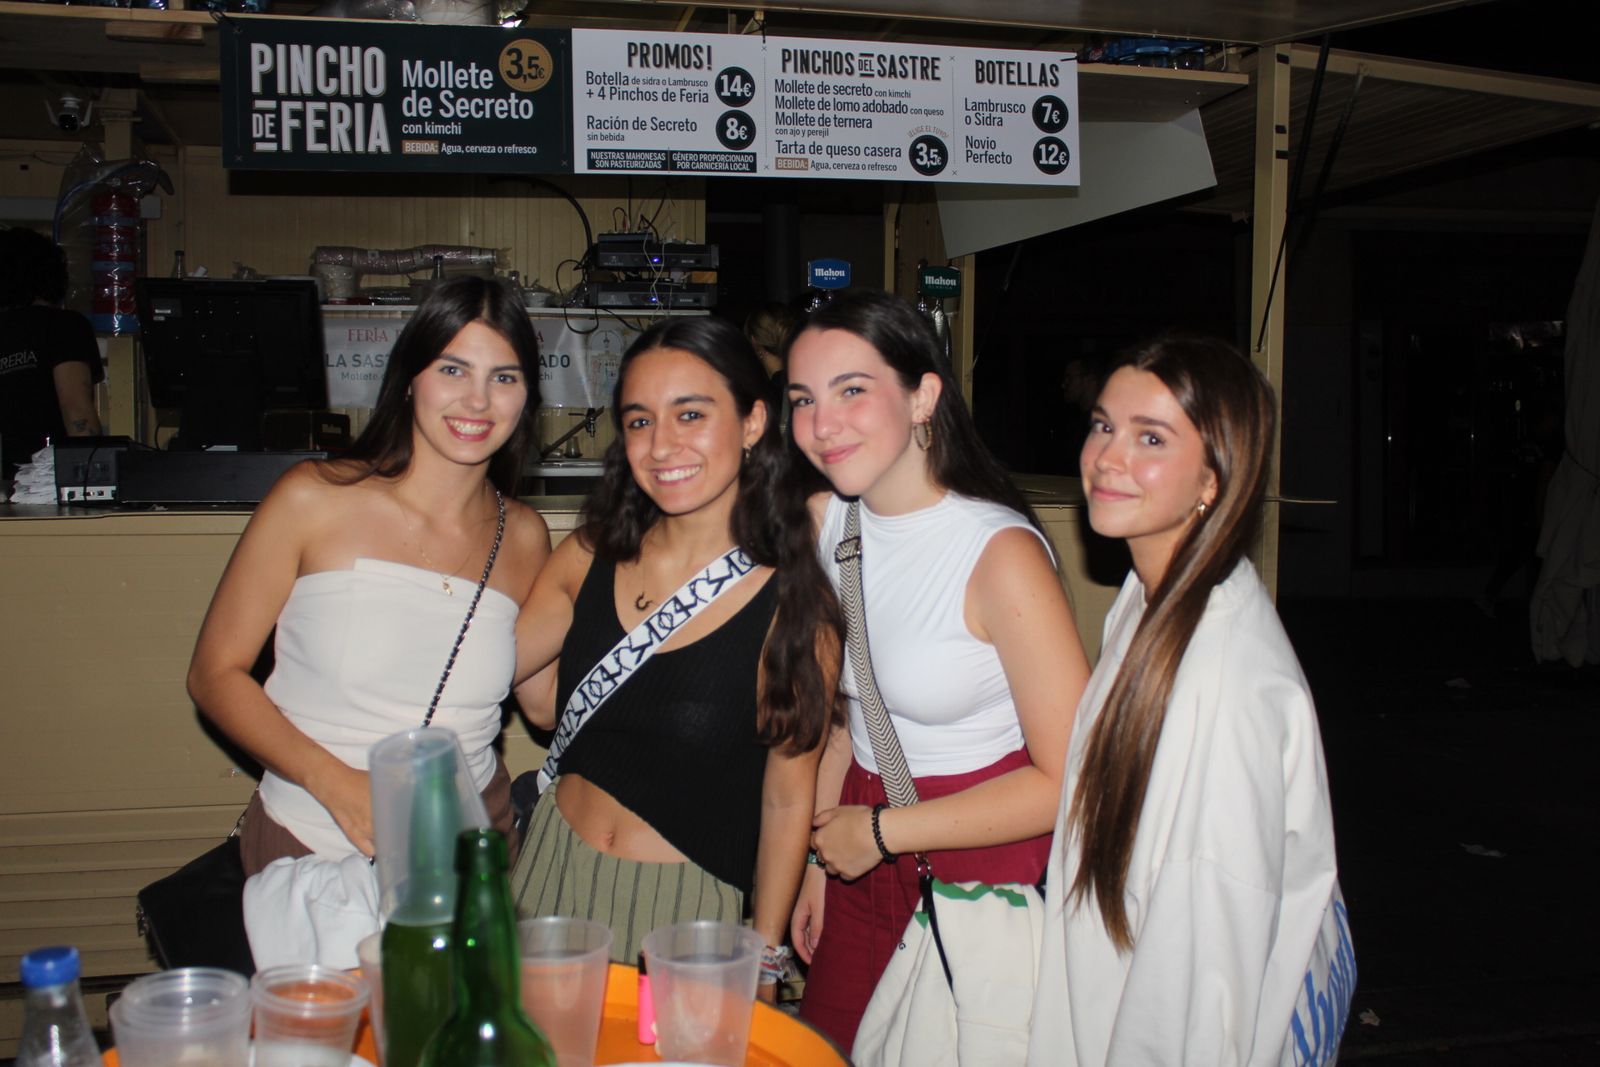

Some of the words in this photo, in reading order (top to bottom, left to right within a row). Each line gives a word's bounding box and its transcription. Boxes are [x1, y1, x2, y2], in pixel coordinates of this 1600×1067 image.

[627, 42, 712, 71] PROMOS!
[781, 48, 855, 76] PINCHOS
[858, 58, 874, 72] DEL
[877, 53, 942, 81] SASTRE
[250, 42, 386, 98] PINCHO
[506, 47, 545, 84] 3,5€
[975, 59, 1060, 88] BOTELLAS
[402, 60, 494, 90] Mollete
[586, 70, 629, 86] Botella
[631, 76, 641, 85] de
[642, 76, 660, 86] sidra
[668, 77, 708, 87] Lambrusco
[720, 74, 752, 97] 14€
[774, 79, 815, 95] Mollete
[817, 82, 830, 95] de
[833, 84, 873, 97] secreto
[874, 90, 886, 98] con
[888, 88, 912, 99] kimchi
[586, 88, 594, 98] +
[598, 88, 606, 100] 4
[609, 87, 658, 102] Pinchos
[662, 88, 676, 102] de
[680, 89, 709, 103] Feria
[402, 92, 432, 118] de
[439, 90, 534, 120] Secreto
[774, 96, 816, 111] Mollete
[817, 98, 830, 112] de
[833, 100, 860, 113] lomo
[862, 100, 908, 114] adobado
[910, 108, 922, 116] con
[924, 108, 944, 118] queso
[964, 98, 1026, 114] Lambrusco
[1041, 102, 1060, 124] 7€
[252, 114, 276, 138] DE
[281, 101, 392, 154] FERIA
[402, 124, 422, 134] con
[425, 122, 462, 135] kimchi
[586, 114, 628, 130] Ración
[632, 117, 647, 131] de
[650, 116, 698, 132] Secreto
[726, 117, 748, 140] 8€
[775, 112, 816, 128] Mollete
[817, 114, 830, 128] de
[833, 116, 872, 129] ternera
[965, 116, 973, 126] o
[974, 114, 1004, 128] Sidra
[587, 133, 598, 141] sin
[600, 134, 625, 142] bebida
[775, 128, 788, 136] con
[790, 128, 801, 137] ajo
[807, 128, 830, 138] perejil
[405, 142, 438, 153] BEBIDA:
[441, 143, 464, 155] Agua,
[465, 146, 496, 154] cerveza
[497, 146, 503, 154] o
[504, 144, 537, 154] refresco
[776, 140, 808, 156] Tarta
[809, 142, 823, 156] de
[826, 145, 861, 159] queso
[863, 146, 902, 158] casera
[966, 136, 996, 150] Novio
[590, 152, 625, 160] NUESTRAS
[626, 152, 666, 161] MAHONESAS
[699, 154, 754, 163] PROPORCIONADO
[915, 142, 942, 168] 3,5€
[966, 150, 1013, 166] Perfecto
[1038, 144, 1068, 166] 12€
[595, 160, 610, 168] SON
[610, 161, 662, 169] PASTEURIZADAS
[676, 162, 690, 170] POR
[730, 163, 751, 171] LOCAL
[777, 159, 808, 170] BEBIDA:
[810, 160, 832, 172] Agua,
[833, 162, 858, 171] cerveza
[867, 162, 898, 172] refresco
[814, 268, 846, 277] Mahou
[924, 275, 958, 287] Mahou
[326, 352, 347, 368] LA
[341, 372, 378, 381] Mollete
